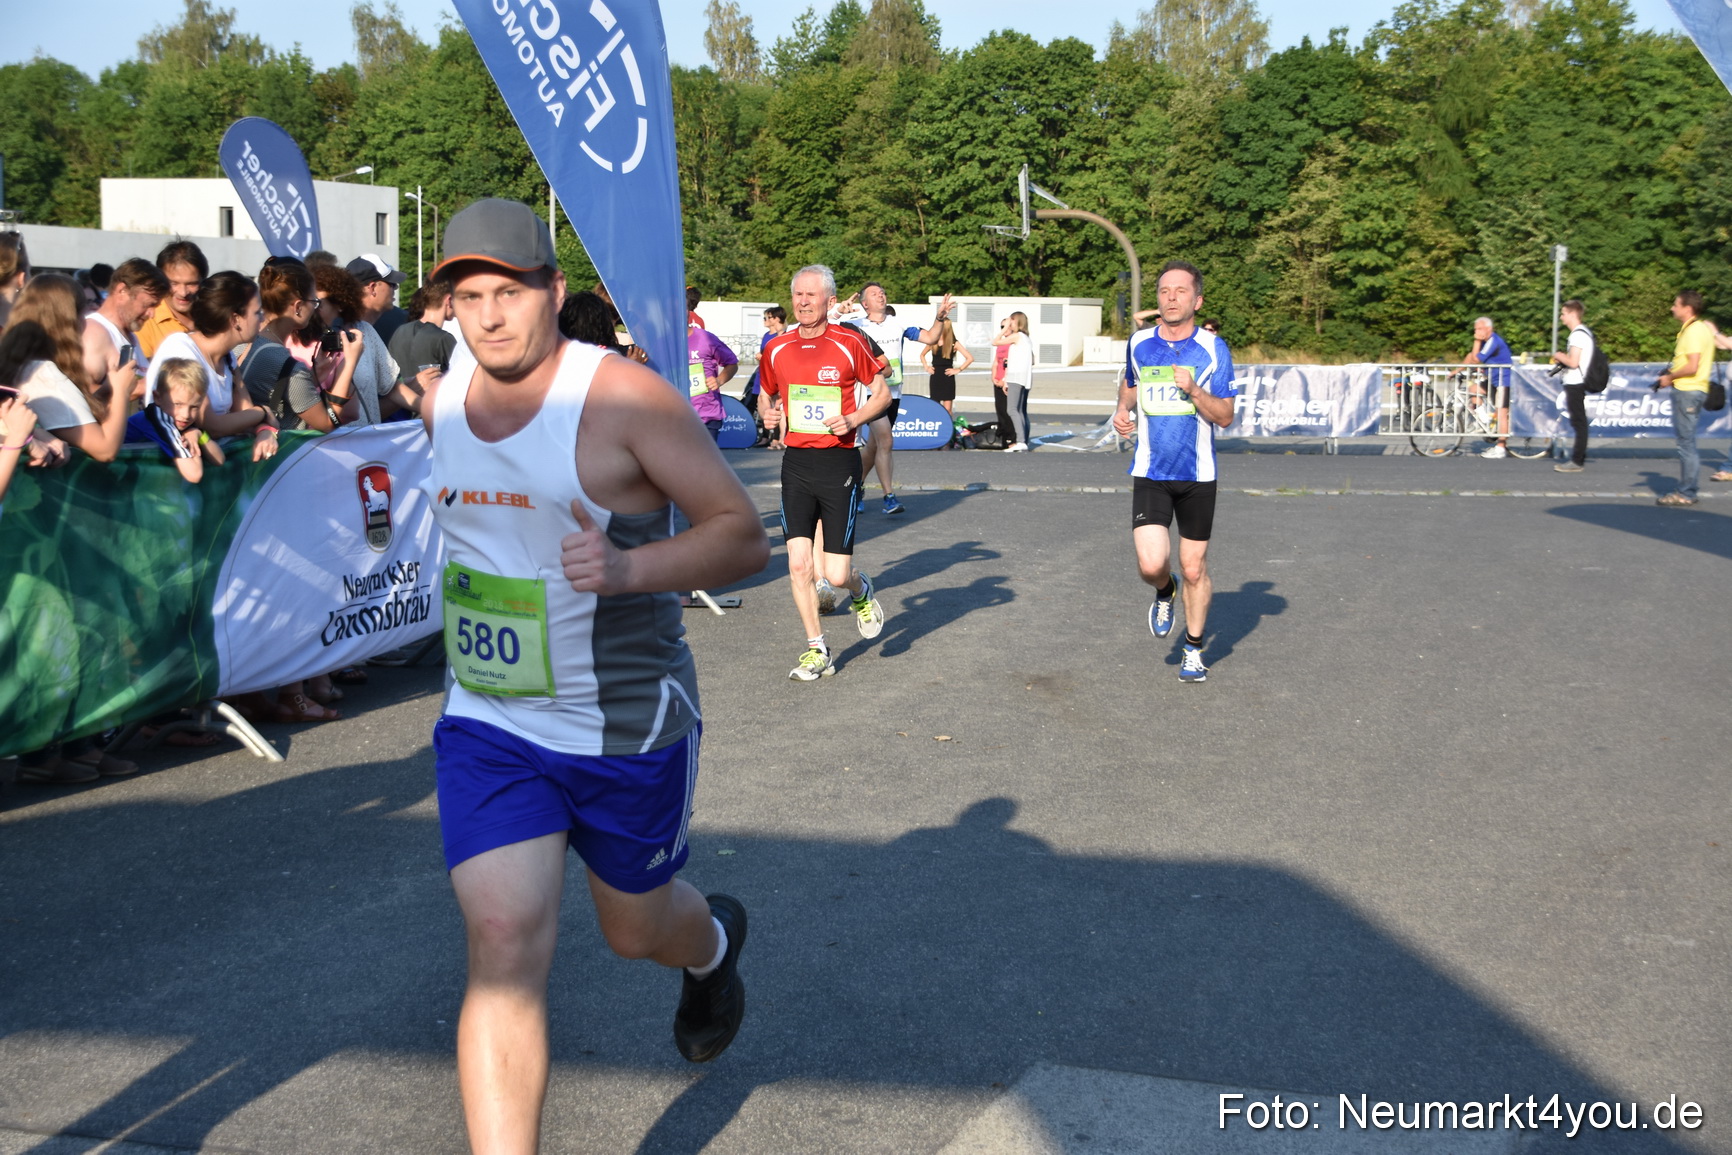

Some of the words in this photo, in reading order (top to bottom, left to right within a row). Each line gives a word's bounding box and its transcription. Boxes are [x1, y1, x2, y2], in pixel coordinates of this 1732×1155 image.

[803, 404, 825, 421] 35
[1234, 394, 1337, 415] Fischer
[1584, 394, 1673, 416] Fische
[892, 418, 943, 430] ischer
[1242, 417, 1329, 426] AUTOMOBILE
[1589, 417, 1673, 427] AUTOMOBIL
[462, 491, 536, 509] KLEBL
[371, 530, 387, 544] 1628
[457, 616, 520, 665] 580
[468, 665, 489, 677] Daniel
[489, 671, 507, 680] Nutz
